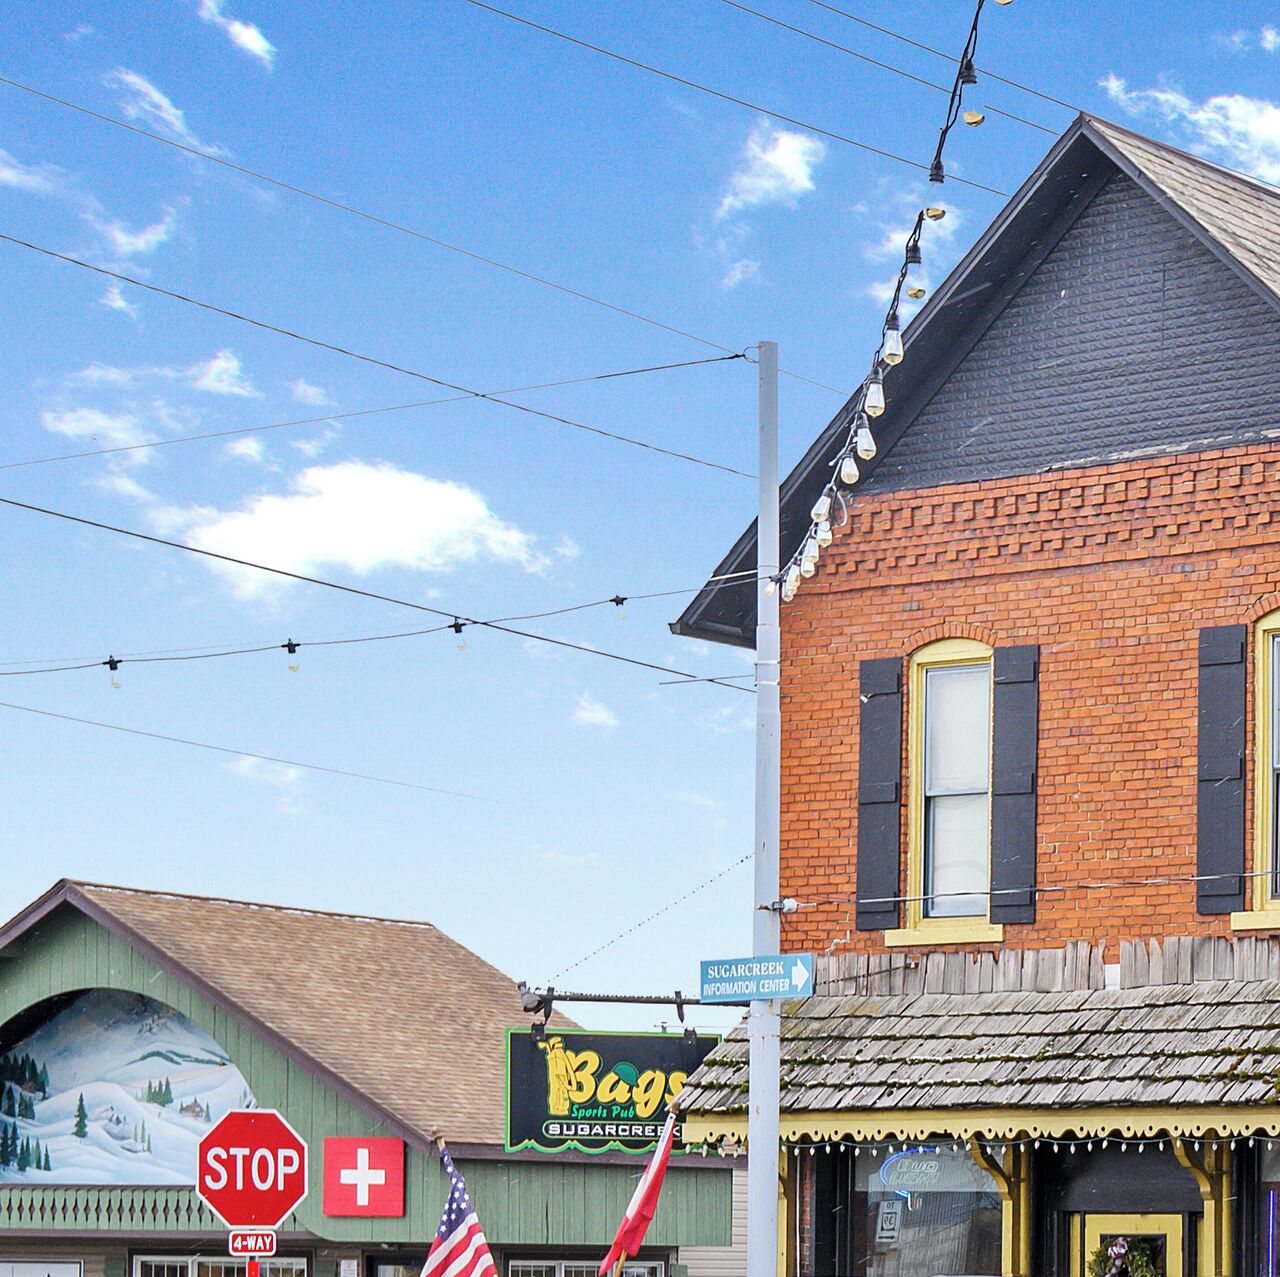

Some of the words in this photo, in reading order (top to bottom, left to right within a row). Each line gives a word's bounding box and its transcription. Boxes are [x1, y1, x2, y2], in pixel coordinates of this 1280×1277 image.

[707, 961, 785, 979] SUGARCREEK
[703, 981, 757, 996] INFORMATION
[759, 978, 790, 993] CENTER
[567, 1050, 688, 1119] Bags
[571, 1104, 607, 1119] Sports
[612, 1105, 635, 1117] Pub
[204, 1146, 300, 1191] STOP
[233, 1236, 272, 1251] 4-WAY
